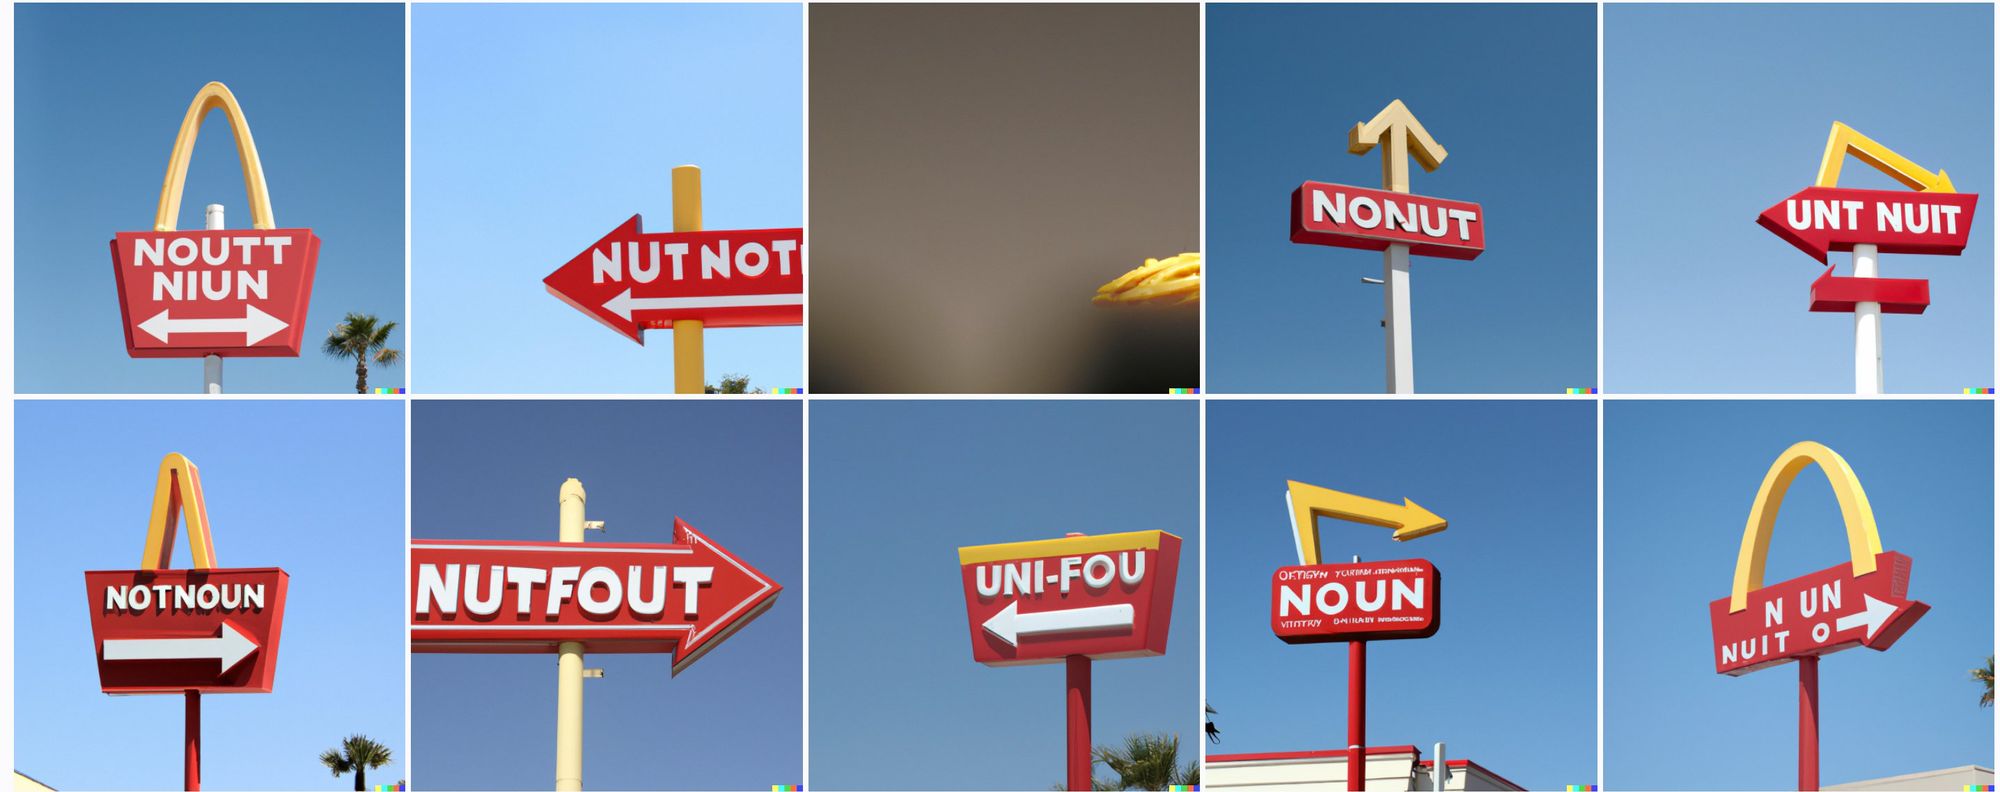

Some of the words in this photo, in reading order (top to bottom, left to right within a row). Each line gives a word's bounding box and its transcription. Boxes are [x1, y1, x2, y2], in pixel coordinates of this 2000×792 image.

[1312, 189, 1477, 241] NONUT
[1787, 199, 1864, 231] UNT
[1876, 201, 1962, 235] NUIT
[133, 236, 292, 267] NOUTT
[592, 241, 689, 284] NUT
[700, 239, 804, 280] NOT
[152, 270, 268, 301] NIUN
[415, 563, 715, 615] NUTFOUT
[976, 550, 1146, 597] UNI-FOU
[106, 584, 265, 610] NOTNOUN
[1279, 577, 1424, 617] NOUN
[1722, 630, 1790, 665] NUIT
[1811, 622, 1831, 644] O
